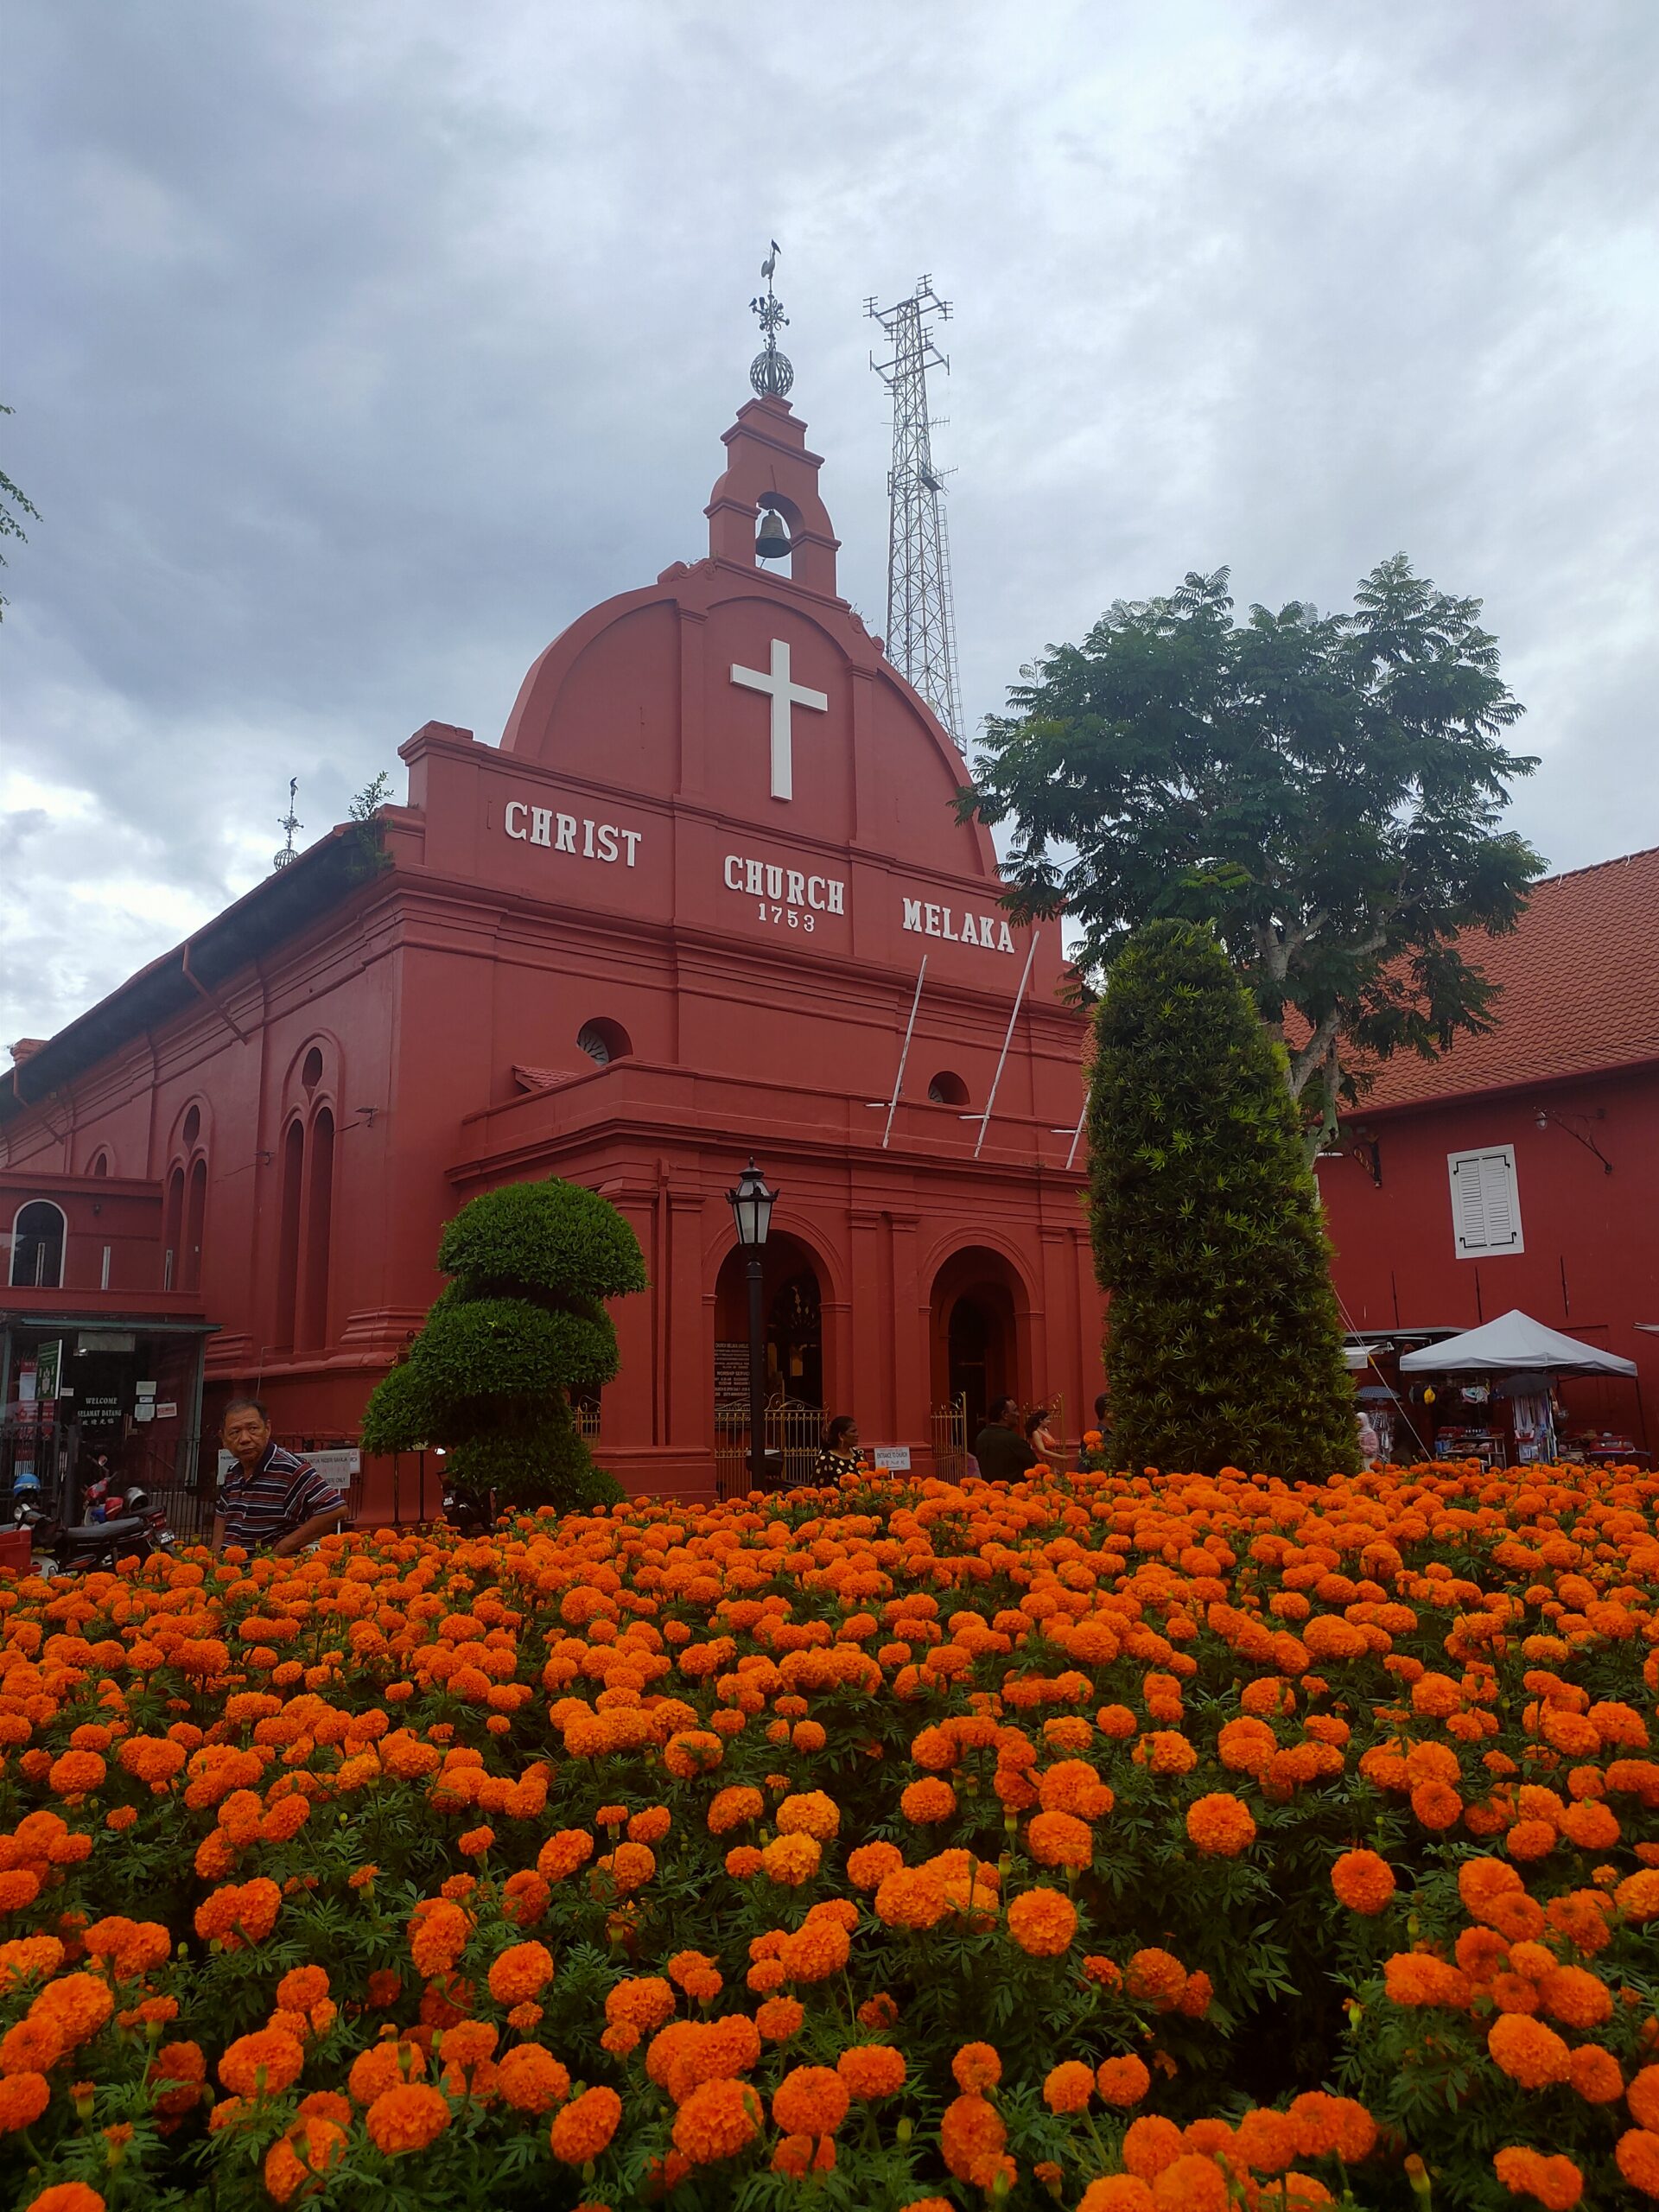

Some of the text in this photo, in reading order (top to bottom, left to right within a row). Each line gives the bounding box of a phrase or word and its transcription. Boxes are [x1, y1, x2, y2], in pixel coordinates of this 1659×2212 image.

[505, 801, 1015, 954] CHRIST CHURCH MELAKA
[758, 902, 816, 933] 1753
[85, 1396, 118, 1405] WELCOME
